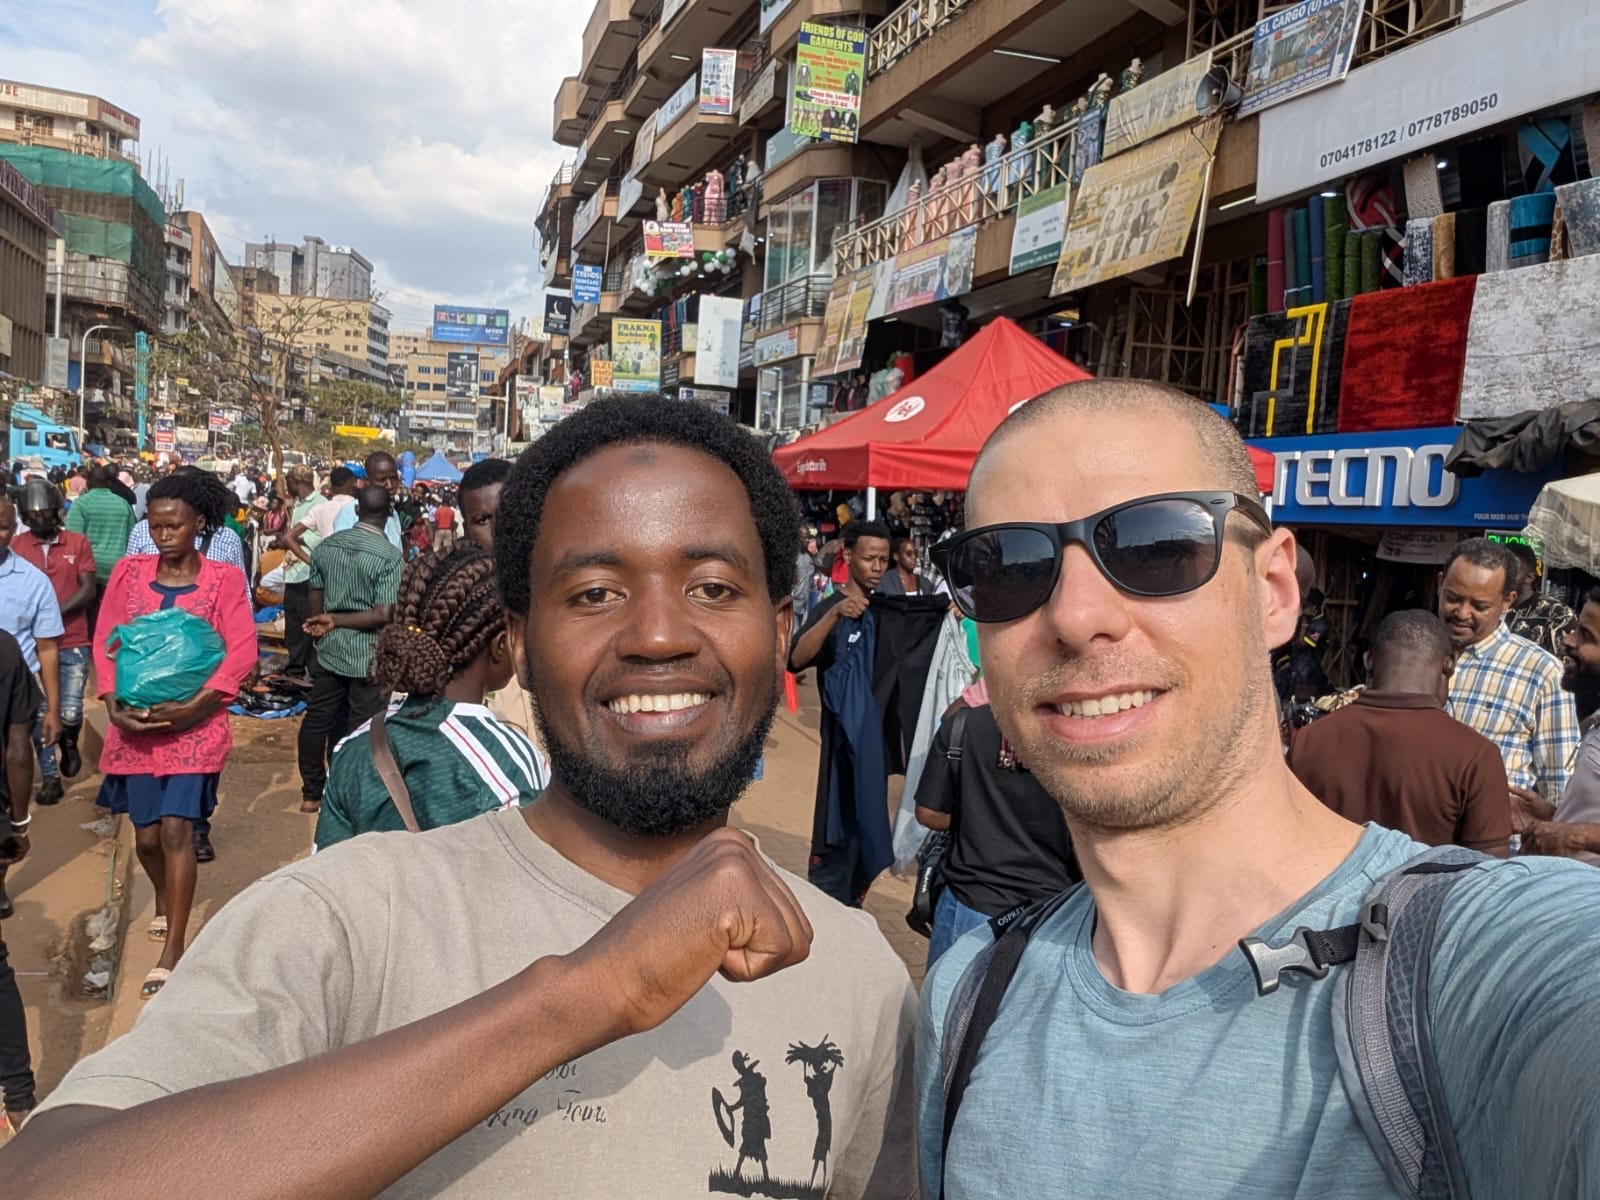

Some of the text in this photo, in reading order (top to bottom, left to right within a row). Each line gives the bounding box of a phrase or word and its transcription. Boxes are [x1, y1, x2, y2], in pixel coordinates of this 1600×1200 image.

[801, 21, 835, 38] FRIENDS
[836, 28, 846, 40] OF
[1259, 23, 1271, 37] SL
[1272, 6, 1306, 29] CARGO
[810, 35, 854, 53] GARMENTS
[1320, 130, 1397, 168] 0704178122
[1408, 93, 1498, 138] 0778789050
[1272, 444, 1455, 507] TECNO
[997, 905, 1025, 925] OSPREY
